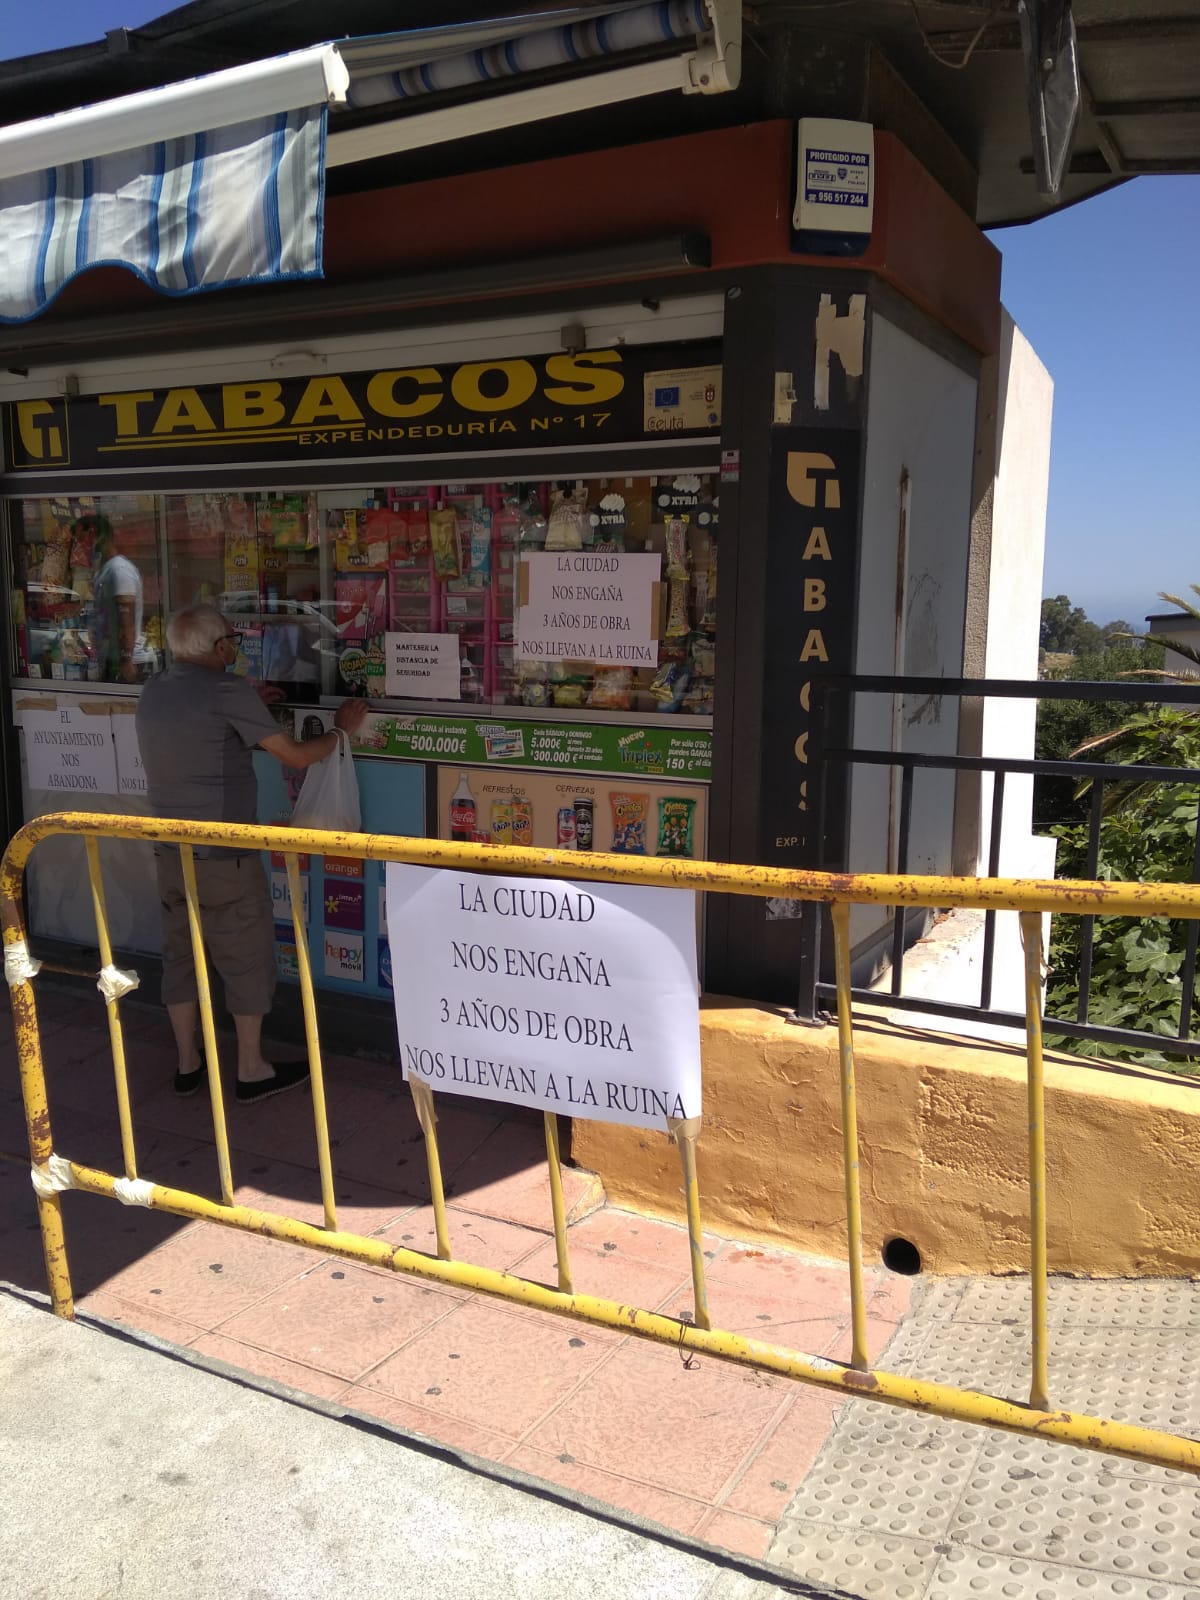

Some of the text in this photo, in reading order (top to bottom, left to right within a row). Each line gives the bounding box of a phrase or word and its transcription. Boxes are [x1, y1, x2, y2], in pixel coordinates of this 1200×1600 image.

[809, 151, 866, 164] PROTEGIDO POR
[818, 192, 864, 205] 956 517 244
[98, 350, 625, 437] TABACOS
[298, 418, 517, 446] EXPENDEDURÍA
[574, 412, 612, 429] 17
[558, 557, 619, 573] LA CIUDAD
[552, 584, 624, 602] NOS ENGAÑA
[543, 612, 631, 631] 3 AÑOS DE OBRA
[522, 639, 652, 661] NOS LLEVAN A LA RUINA
[60, 710, 71, 724] EL
[34, 732, 104, 746] AYUNTAMIENTO
[62, 753, 80, 767] NOS
[533, 750, 570, 763] 300.000
[618, 746, 663, 765] Triplex
[665, 757, 685, 770] 150
[687, 760, 695, 771] €
[48, 774, 98, 790] ABANDONA
[121, 778, 137, 790] NOS
[555, 784, 595, 795] CERVEZAS
[325, 863, 359, 875] orange
[458, 883, 595, 923] LA CIUDAD
[325, 940, 361, 962] happy
[451, 941, 612, 988] NOS ENGAÑA
[440, 998, 634, 1052] 3 AÑOS DE OBRA
[404, 1043, 688, 1120] NOS LLEVAN A LA RUINA
